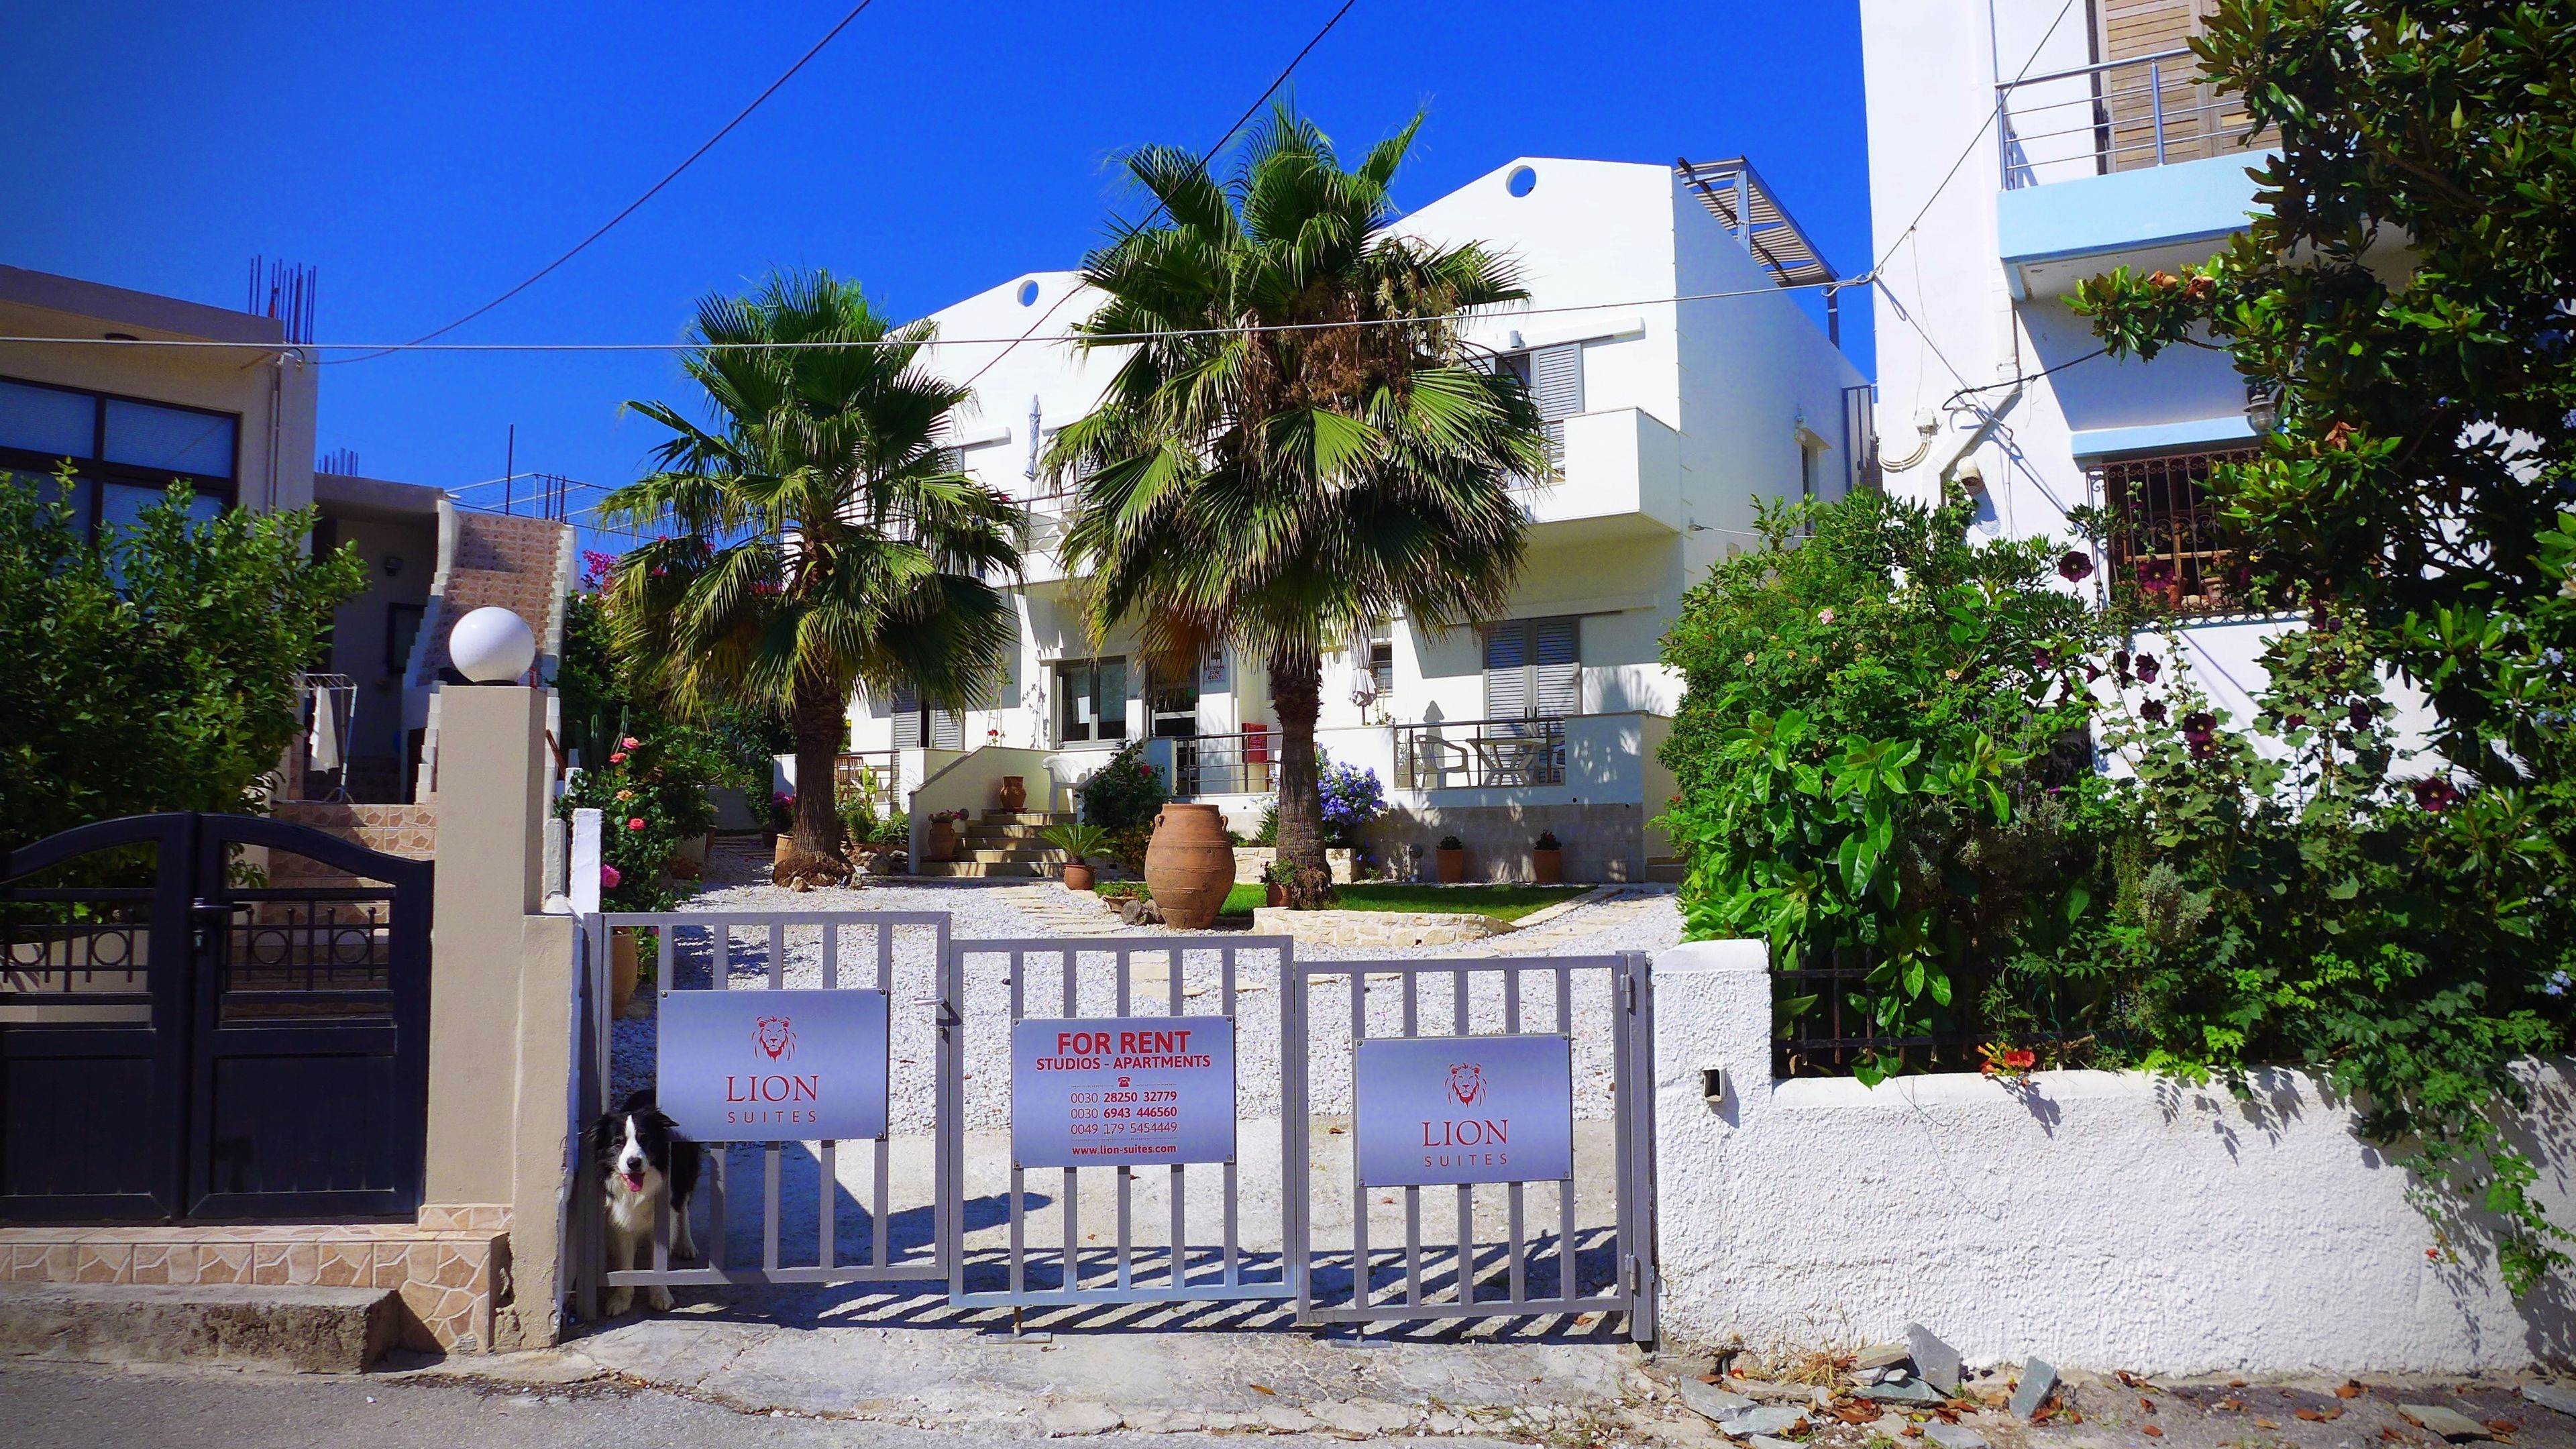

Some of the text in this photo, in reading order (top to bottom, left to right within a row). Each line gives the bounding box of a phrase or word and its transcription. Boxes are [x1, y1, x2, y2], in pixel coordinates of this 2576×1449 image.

[1057, 1030, 1191, 1055] FOR RENT
[1036, 1057, 1101, 1071] STUDIOS
[1113, 1055, 1211, 1069] APARTMENTS
[726, 1075, 820, 1102] LION
[1071, 1091, 1177, 1104] 0030 28250 32779
[727, 1110, 816, 1124] SUITES
[1071, 1106, 1177, 1119] 0030 6943 446560
[1071, 1122, 1177, 1135] 0049 179 5454449
[1421, 1119, 1509, 1147] LION
[1072, 1144, 1176, 1155] www.lion-suites.com
[1424, 1153, 1507, 1167] SUITES
